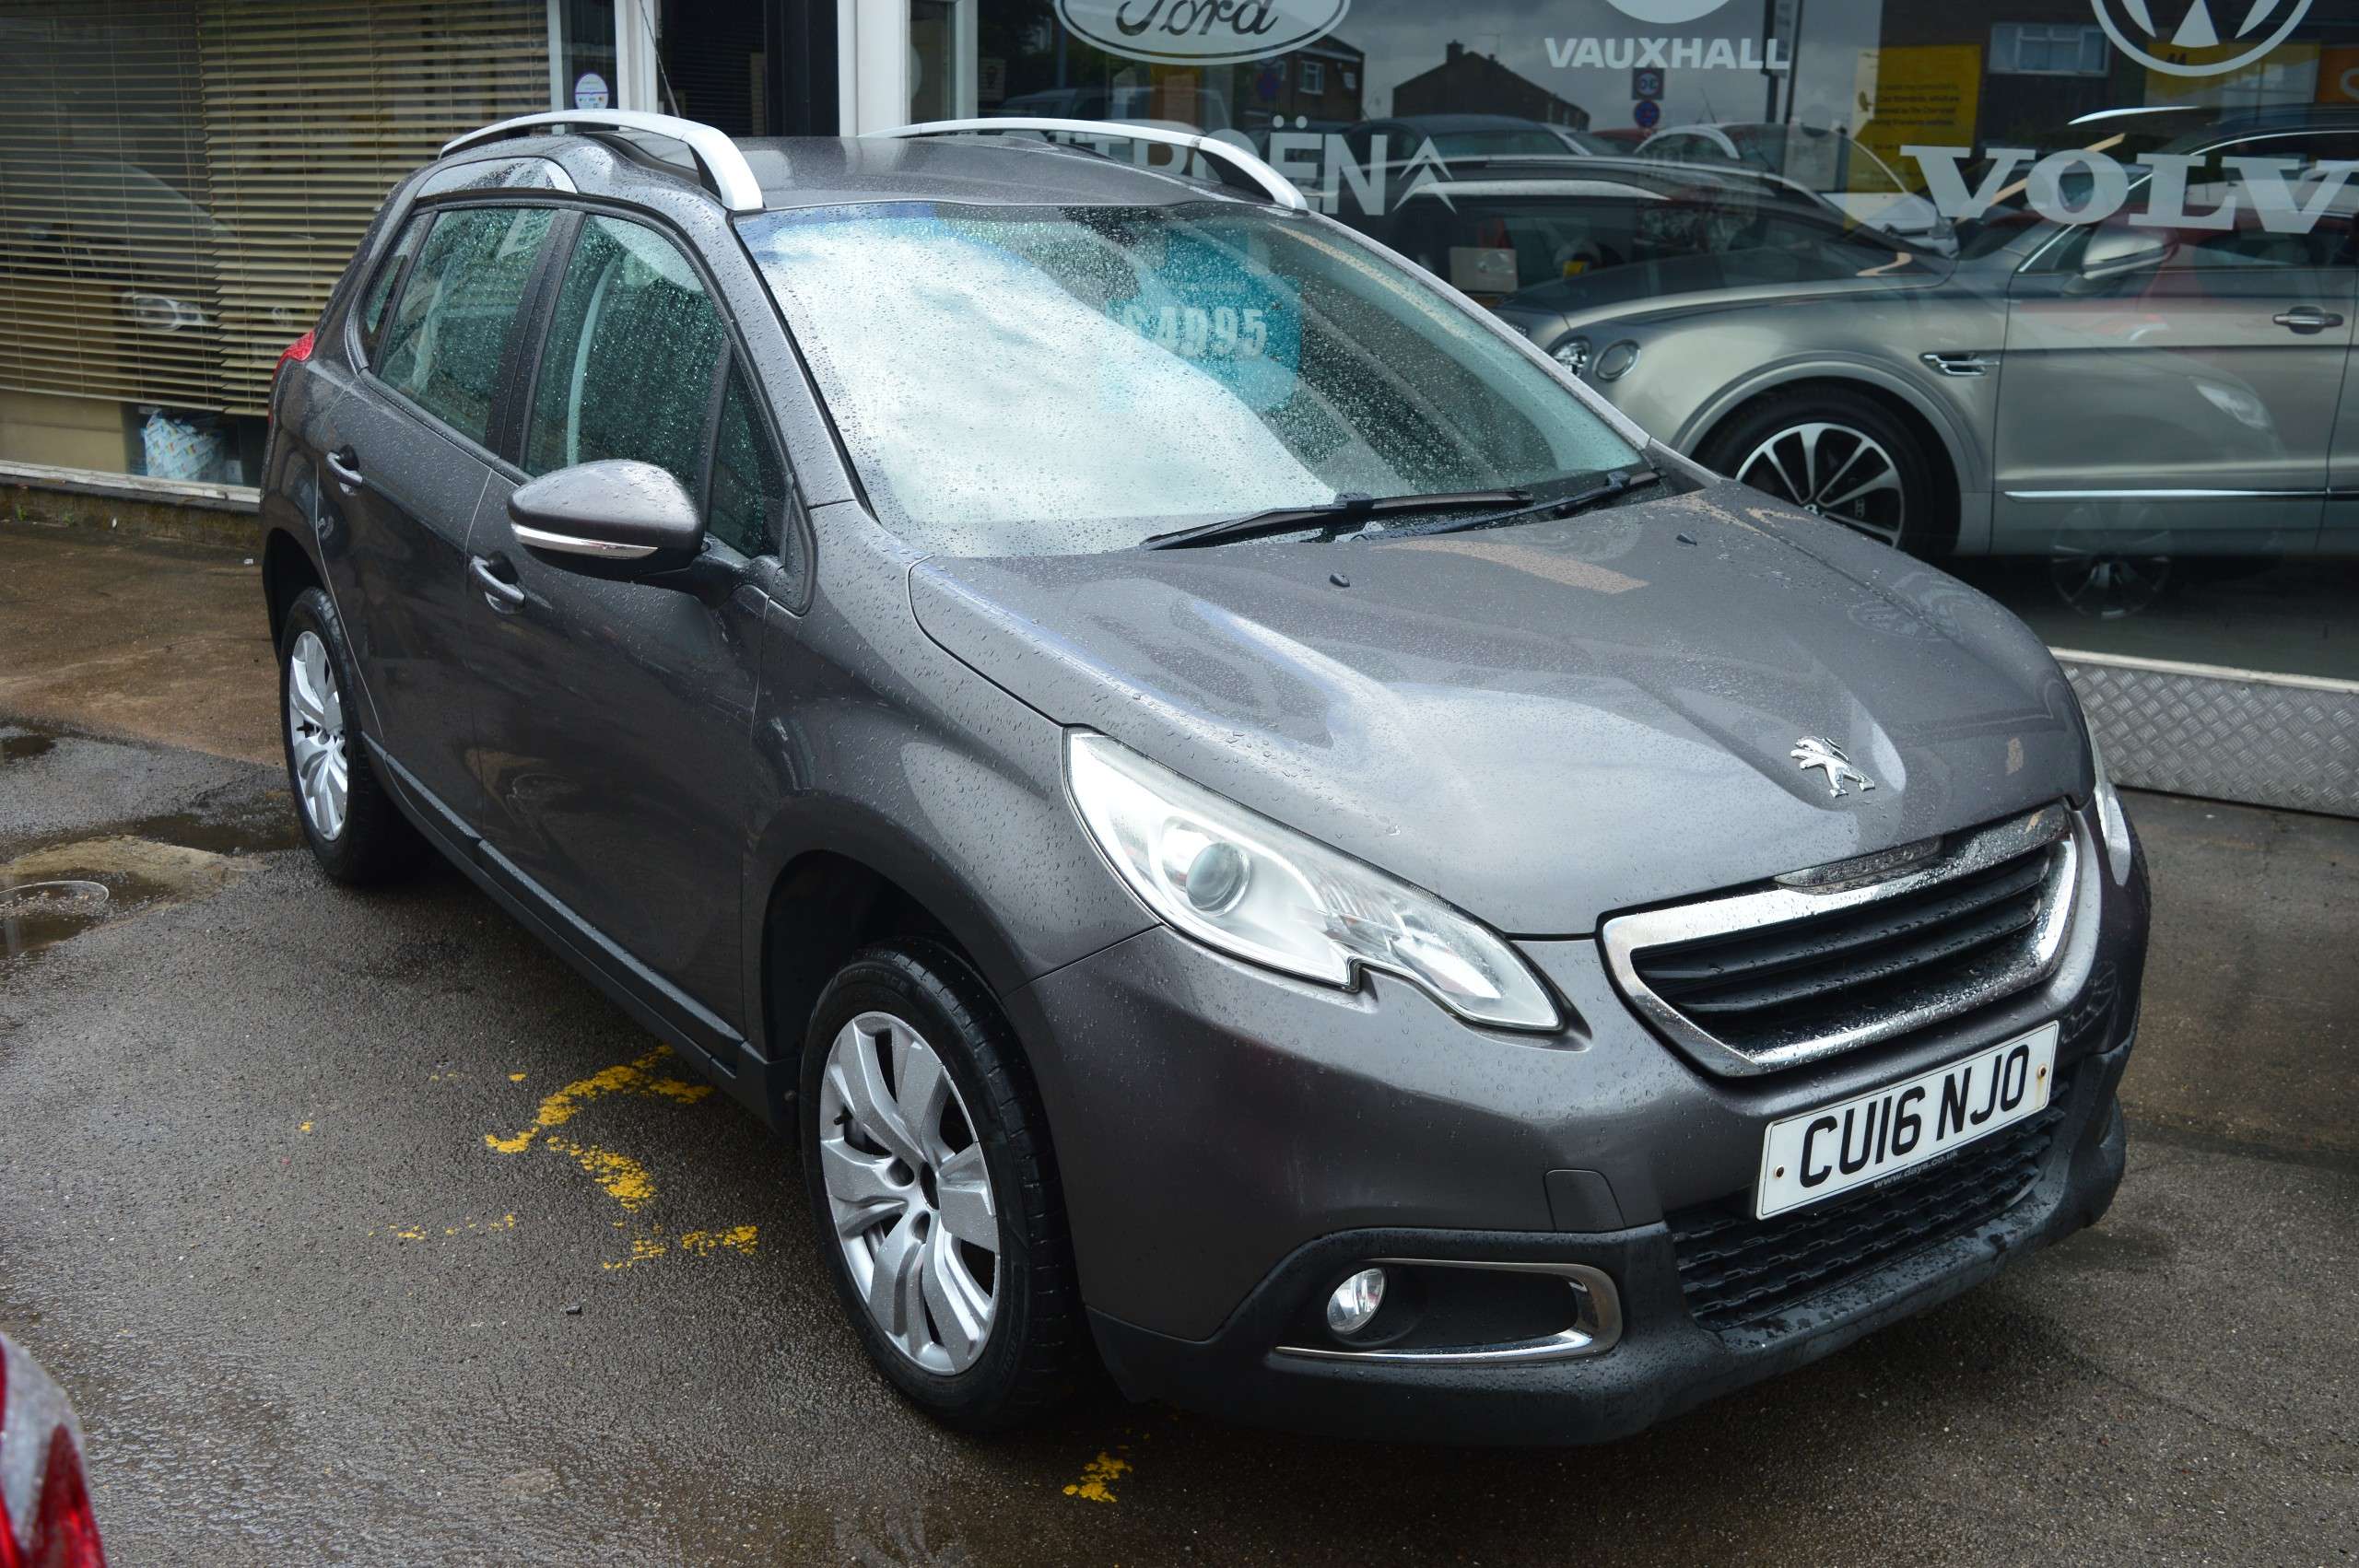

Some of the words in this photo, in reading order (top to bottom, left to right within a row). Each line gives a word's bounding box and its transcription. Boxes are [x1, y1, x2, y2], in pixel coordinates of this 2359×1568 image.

[1544, 37, 1790, 70] VAUXHALL
[1799, 1085, 1926, 1188] CU16
[1936, 1044, 2030, 1141] NJO
[1873, 1150, 1959, 1188] www.days.co.uk
